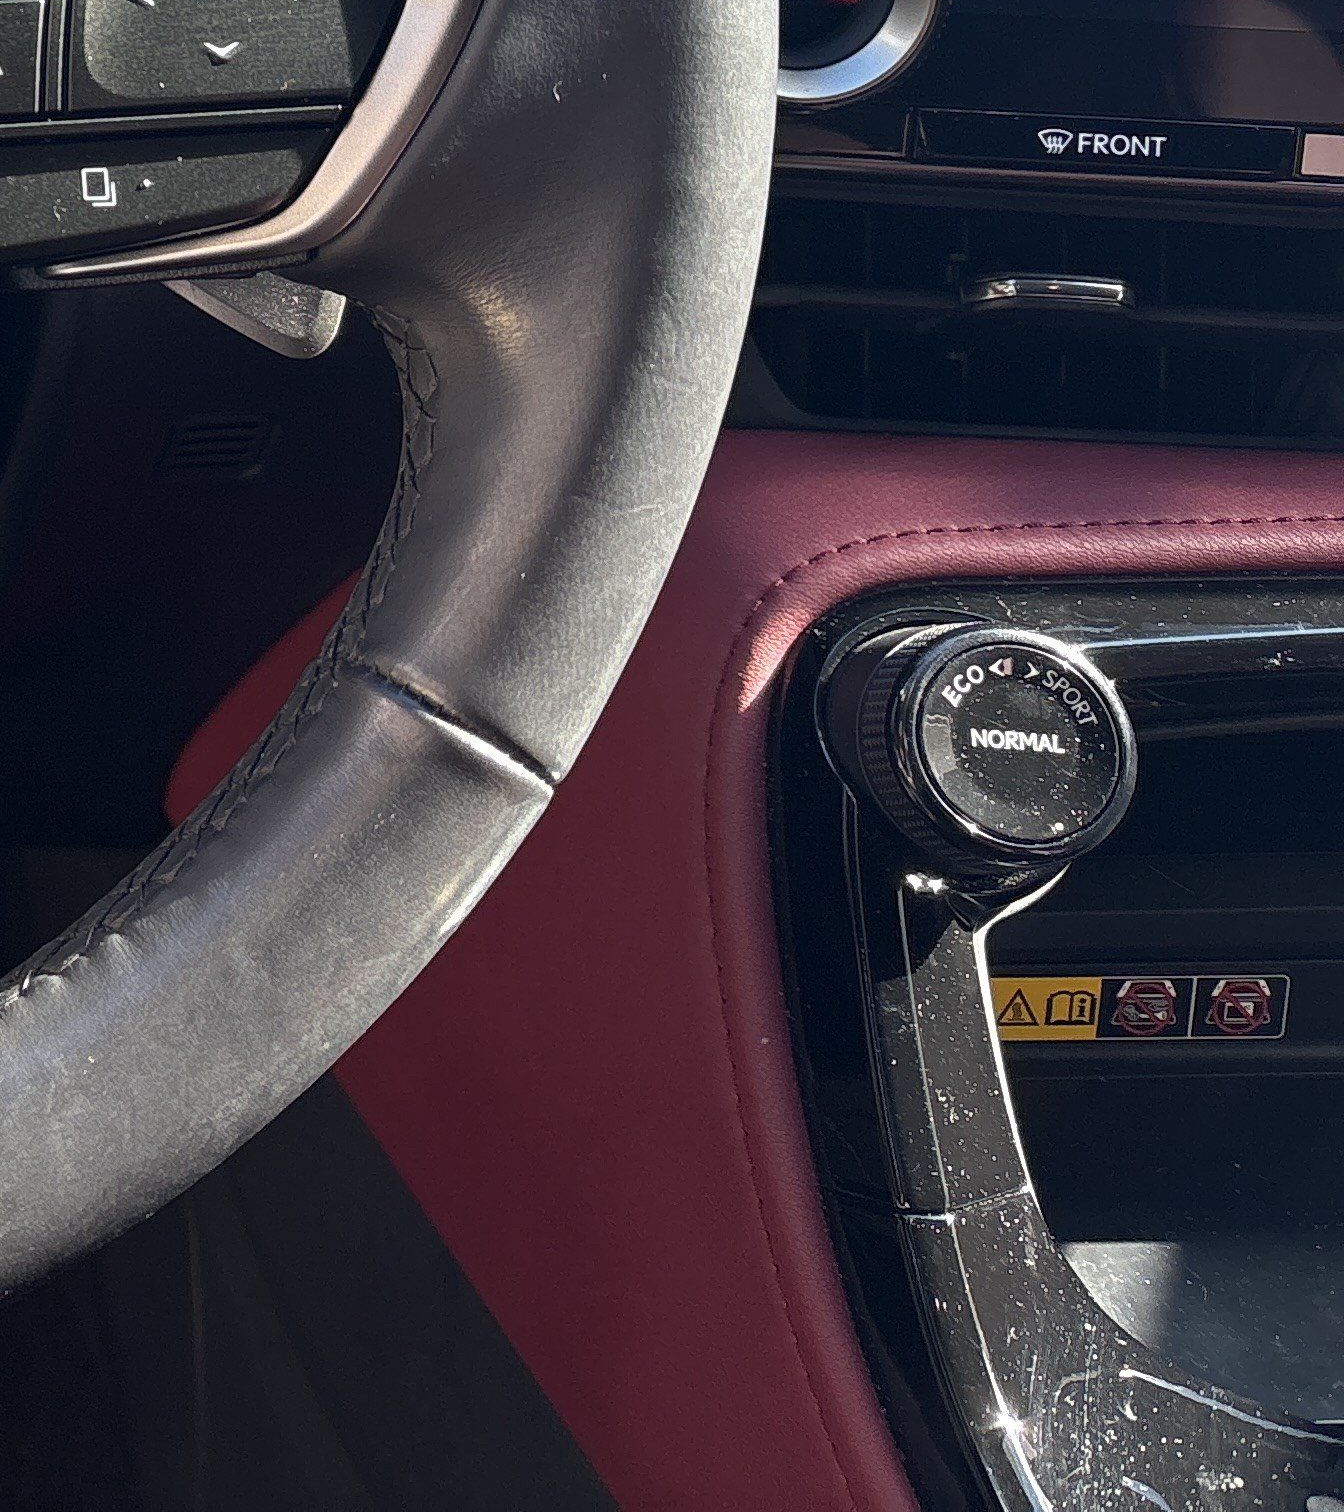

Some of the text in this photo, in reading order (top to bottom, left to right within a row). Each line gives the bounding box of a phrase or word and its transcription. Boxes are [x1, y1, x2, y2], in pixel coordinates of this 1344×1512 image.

[1077, 131, 1168, 158] FRONT
[941, 665, 984, 708] ECO
[1041, 669, 1099, 726] SPORT
[970, 727, 1066, 754] NORMAL
